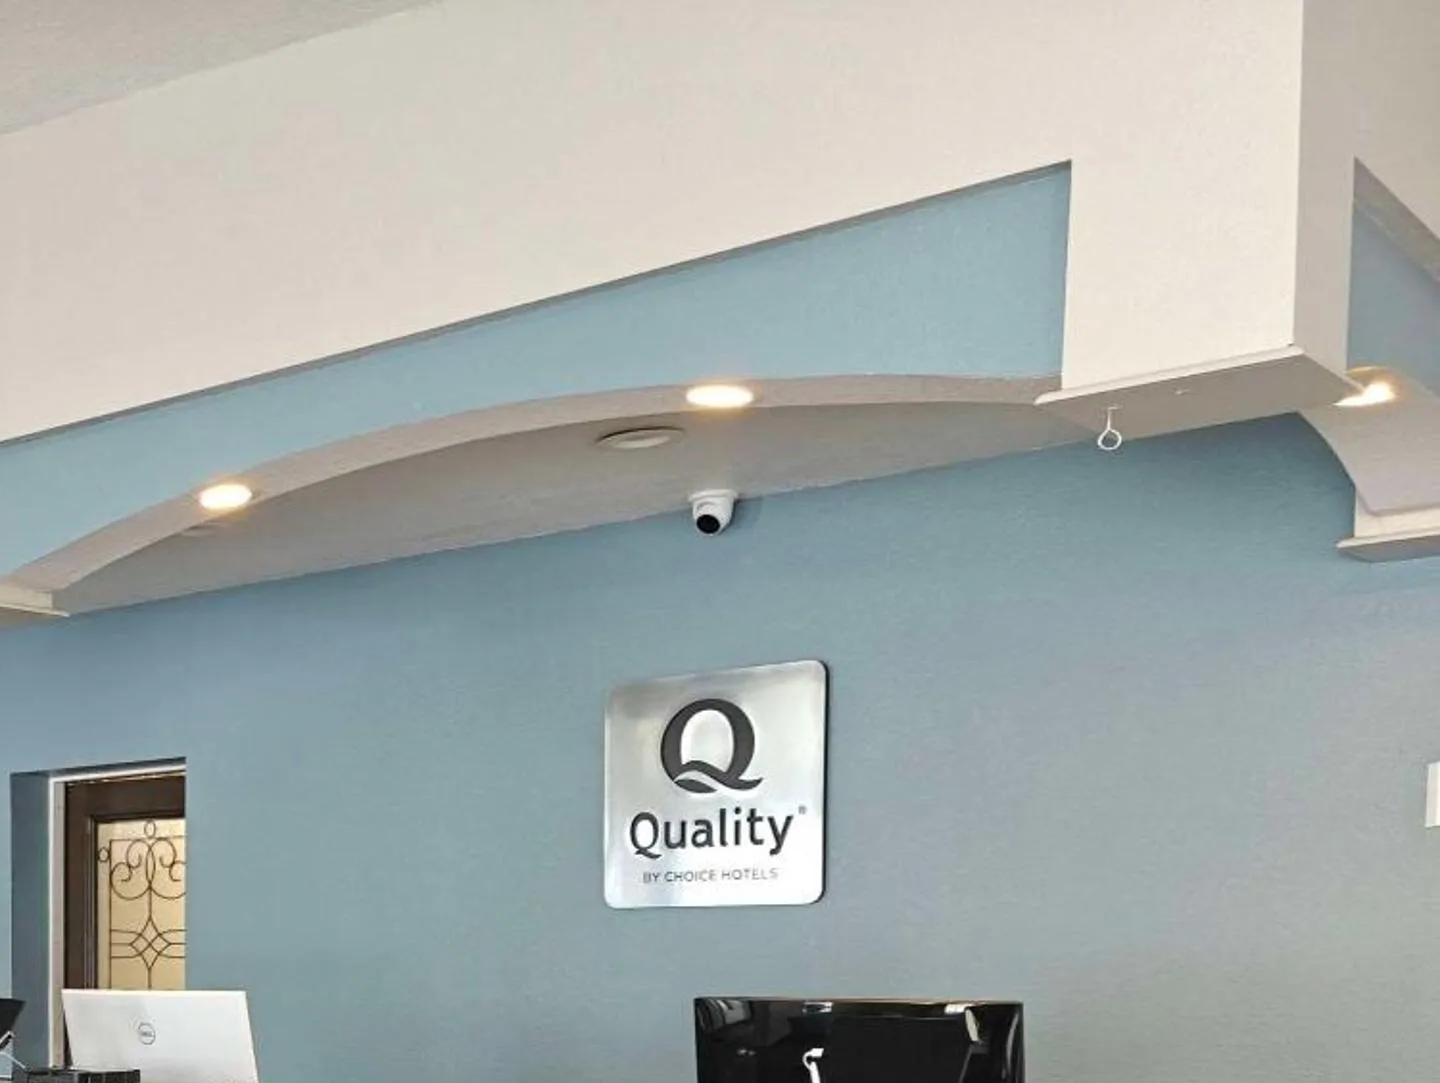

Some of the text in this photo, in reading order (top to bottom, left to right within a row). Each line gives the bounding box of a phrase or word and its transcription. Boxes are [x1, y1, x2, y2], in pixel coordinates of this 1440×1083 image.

[661, 698, 763, 793] Q
[629, 806, 794, 859] Quality
[643, 867, 779, 884] BY CHOICE HOTELS
